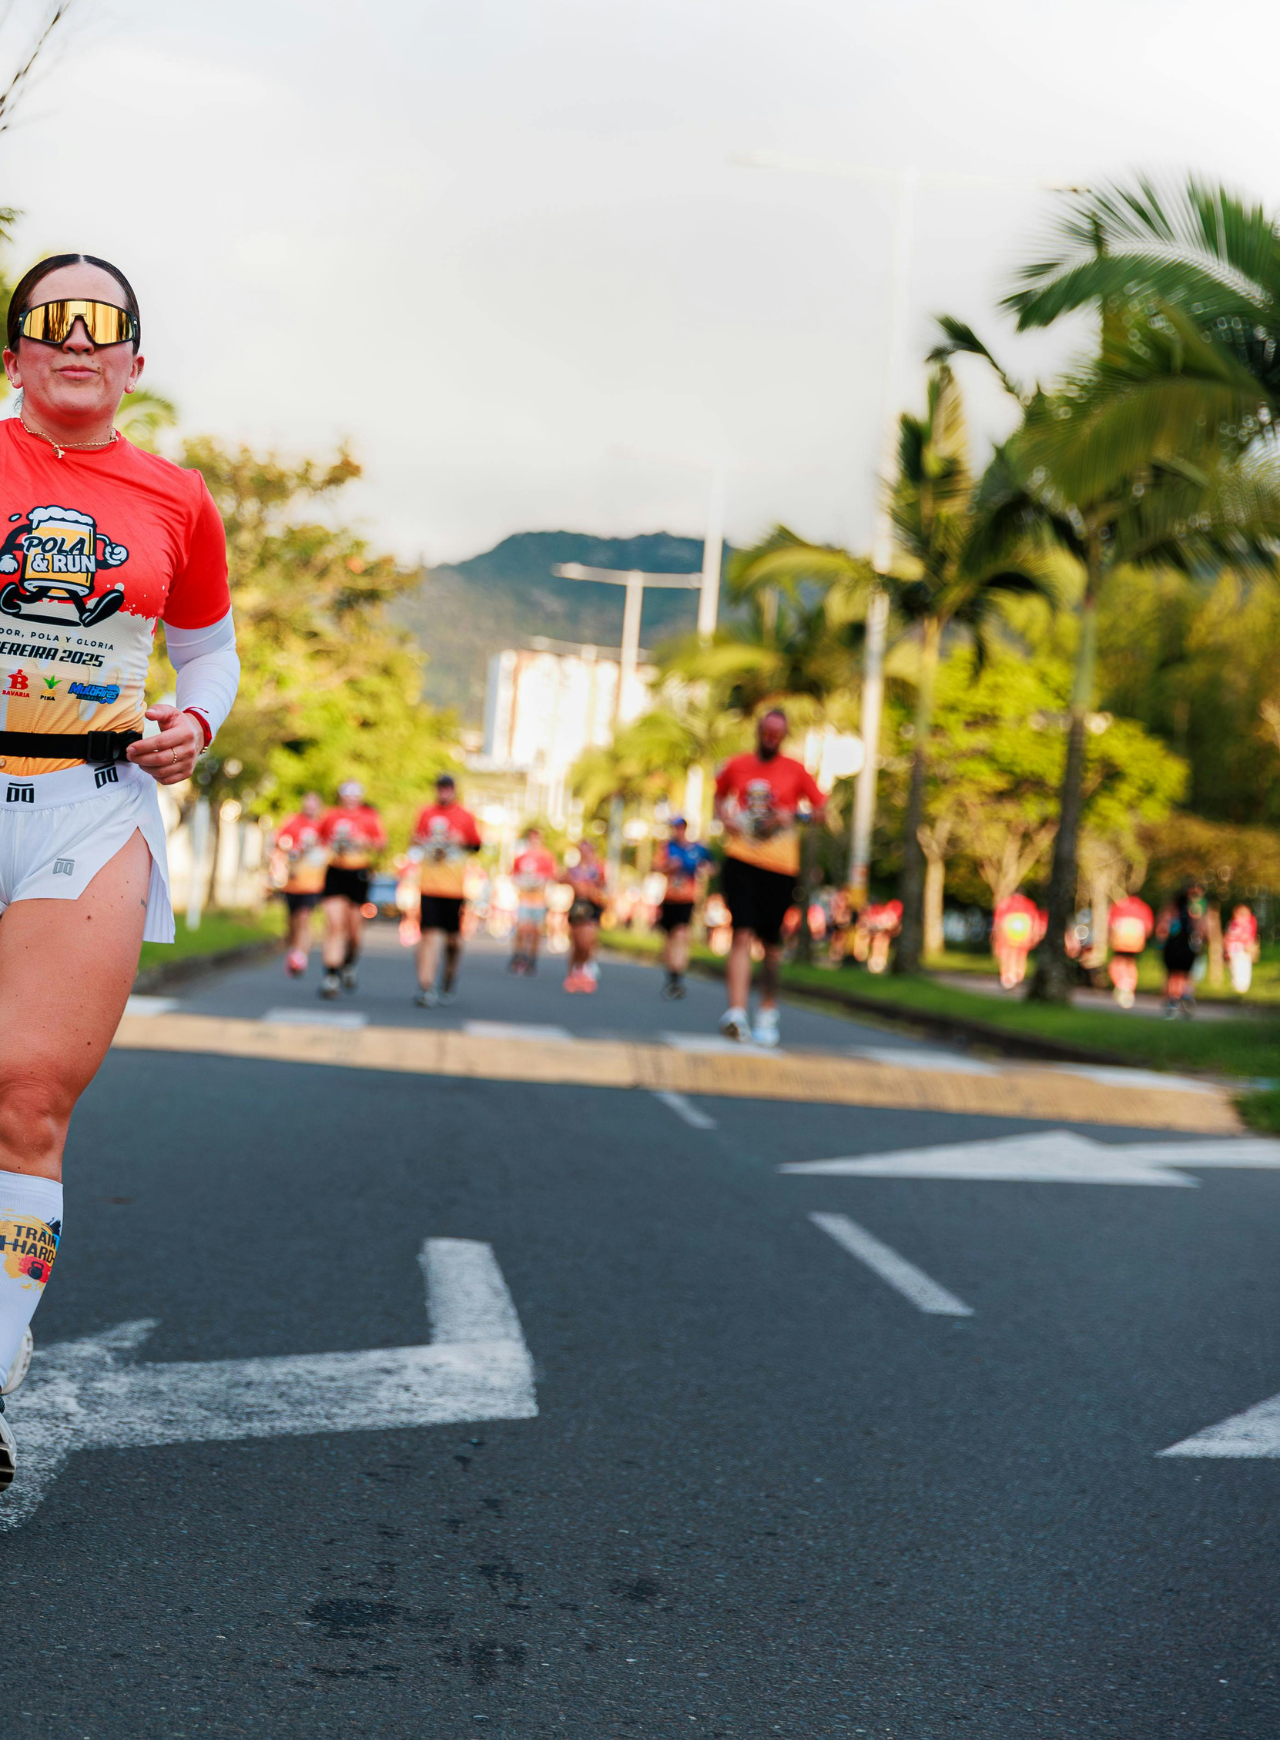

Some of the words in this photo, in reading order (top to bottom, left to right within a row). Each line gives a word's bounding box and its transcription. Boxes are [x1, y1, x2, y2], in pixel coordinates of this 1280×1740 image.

[22, 535, 87, 555] POLA
[32, 554, 49, 573] &
[52, 554, 97, 573] RUN
[30, 631, 59, 642] POLA
[76, 638, 114, 651] GLORIA
[59, 649, 105, 667] 2025
[2, 690, 30, 698] BAVARIA
[12, 1238, 55, 1263] HARD
